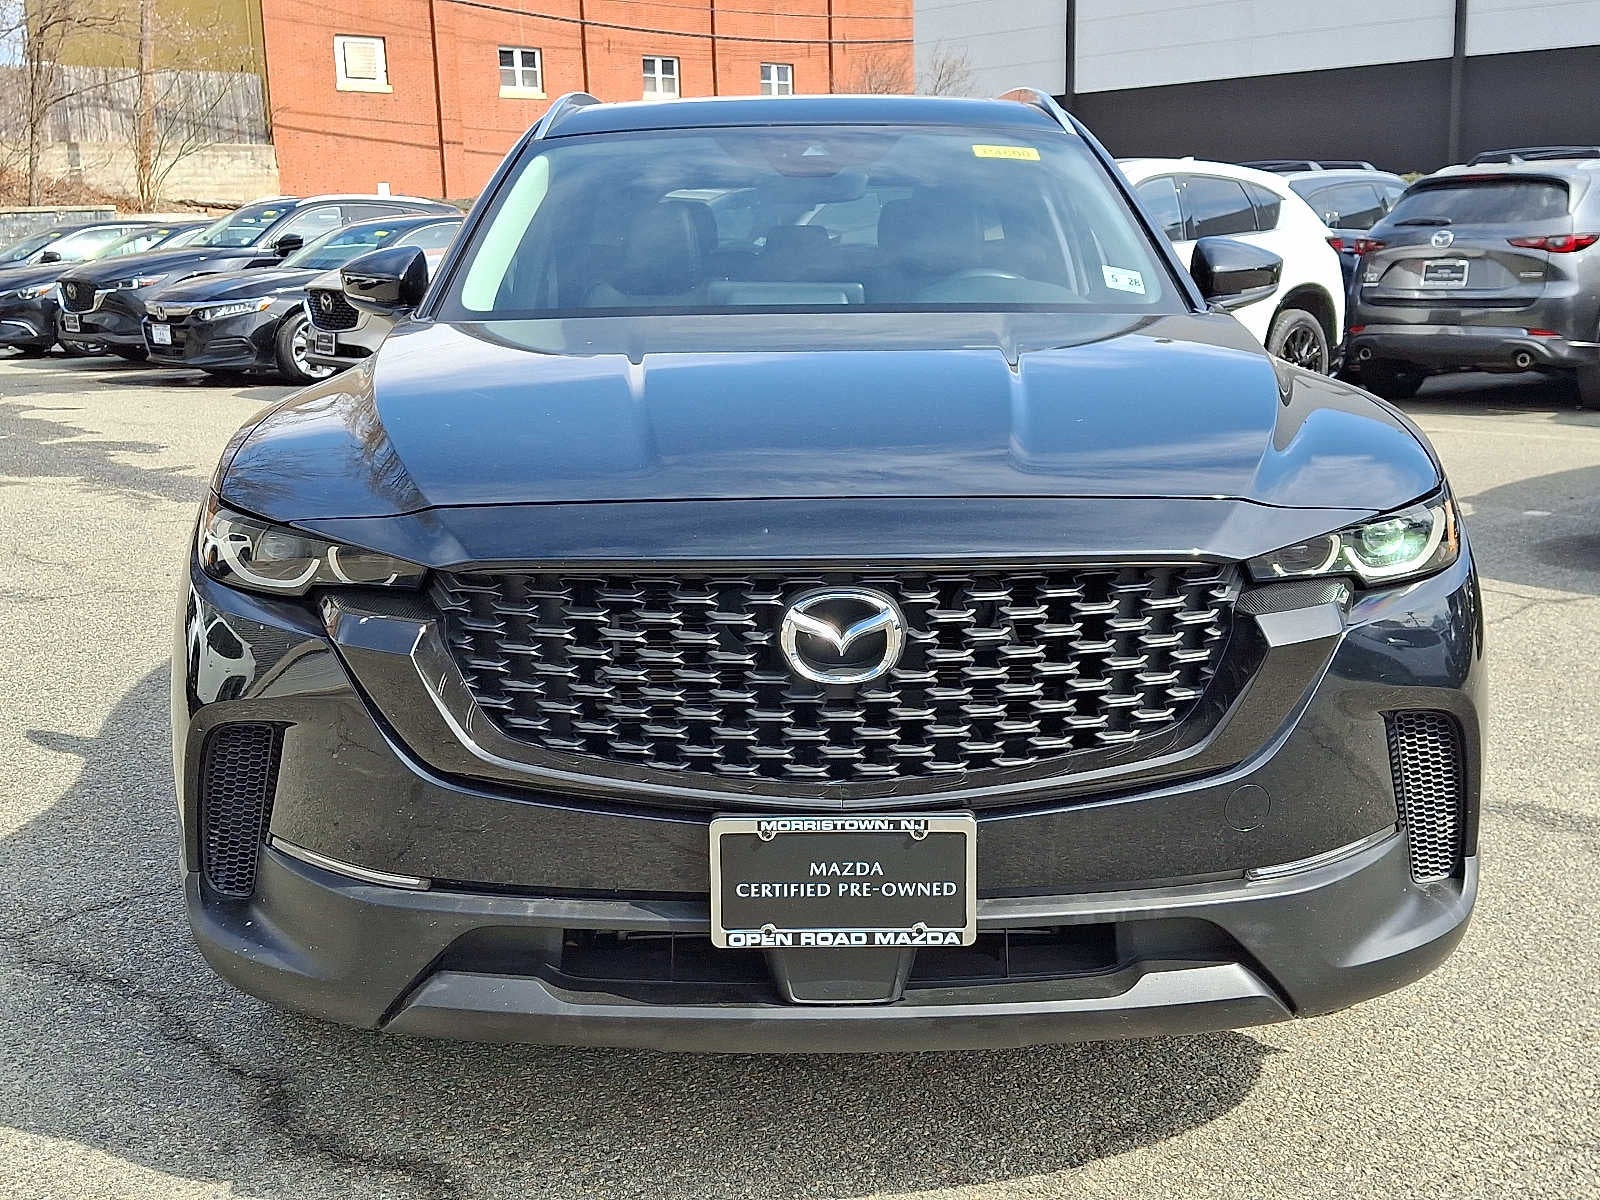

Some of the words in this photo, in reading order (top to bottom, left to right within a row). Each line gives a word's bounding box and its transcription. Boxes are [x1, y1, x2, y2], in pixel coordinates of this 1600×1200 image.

[760, 820, 894, 831] MORRISTOWN,
[901, 820, 925, 831] NJ
[809, 862, 884, 876] MAZDA
[735, 882, 831, 898] CERTIFIED
[838, 881, 957, 897] PRE-OWNED
[728, 932, 793, 946] OPEN
[800, 932, 869, 946] ROAD
[875, 931, 961, 945] MAZDA
